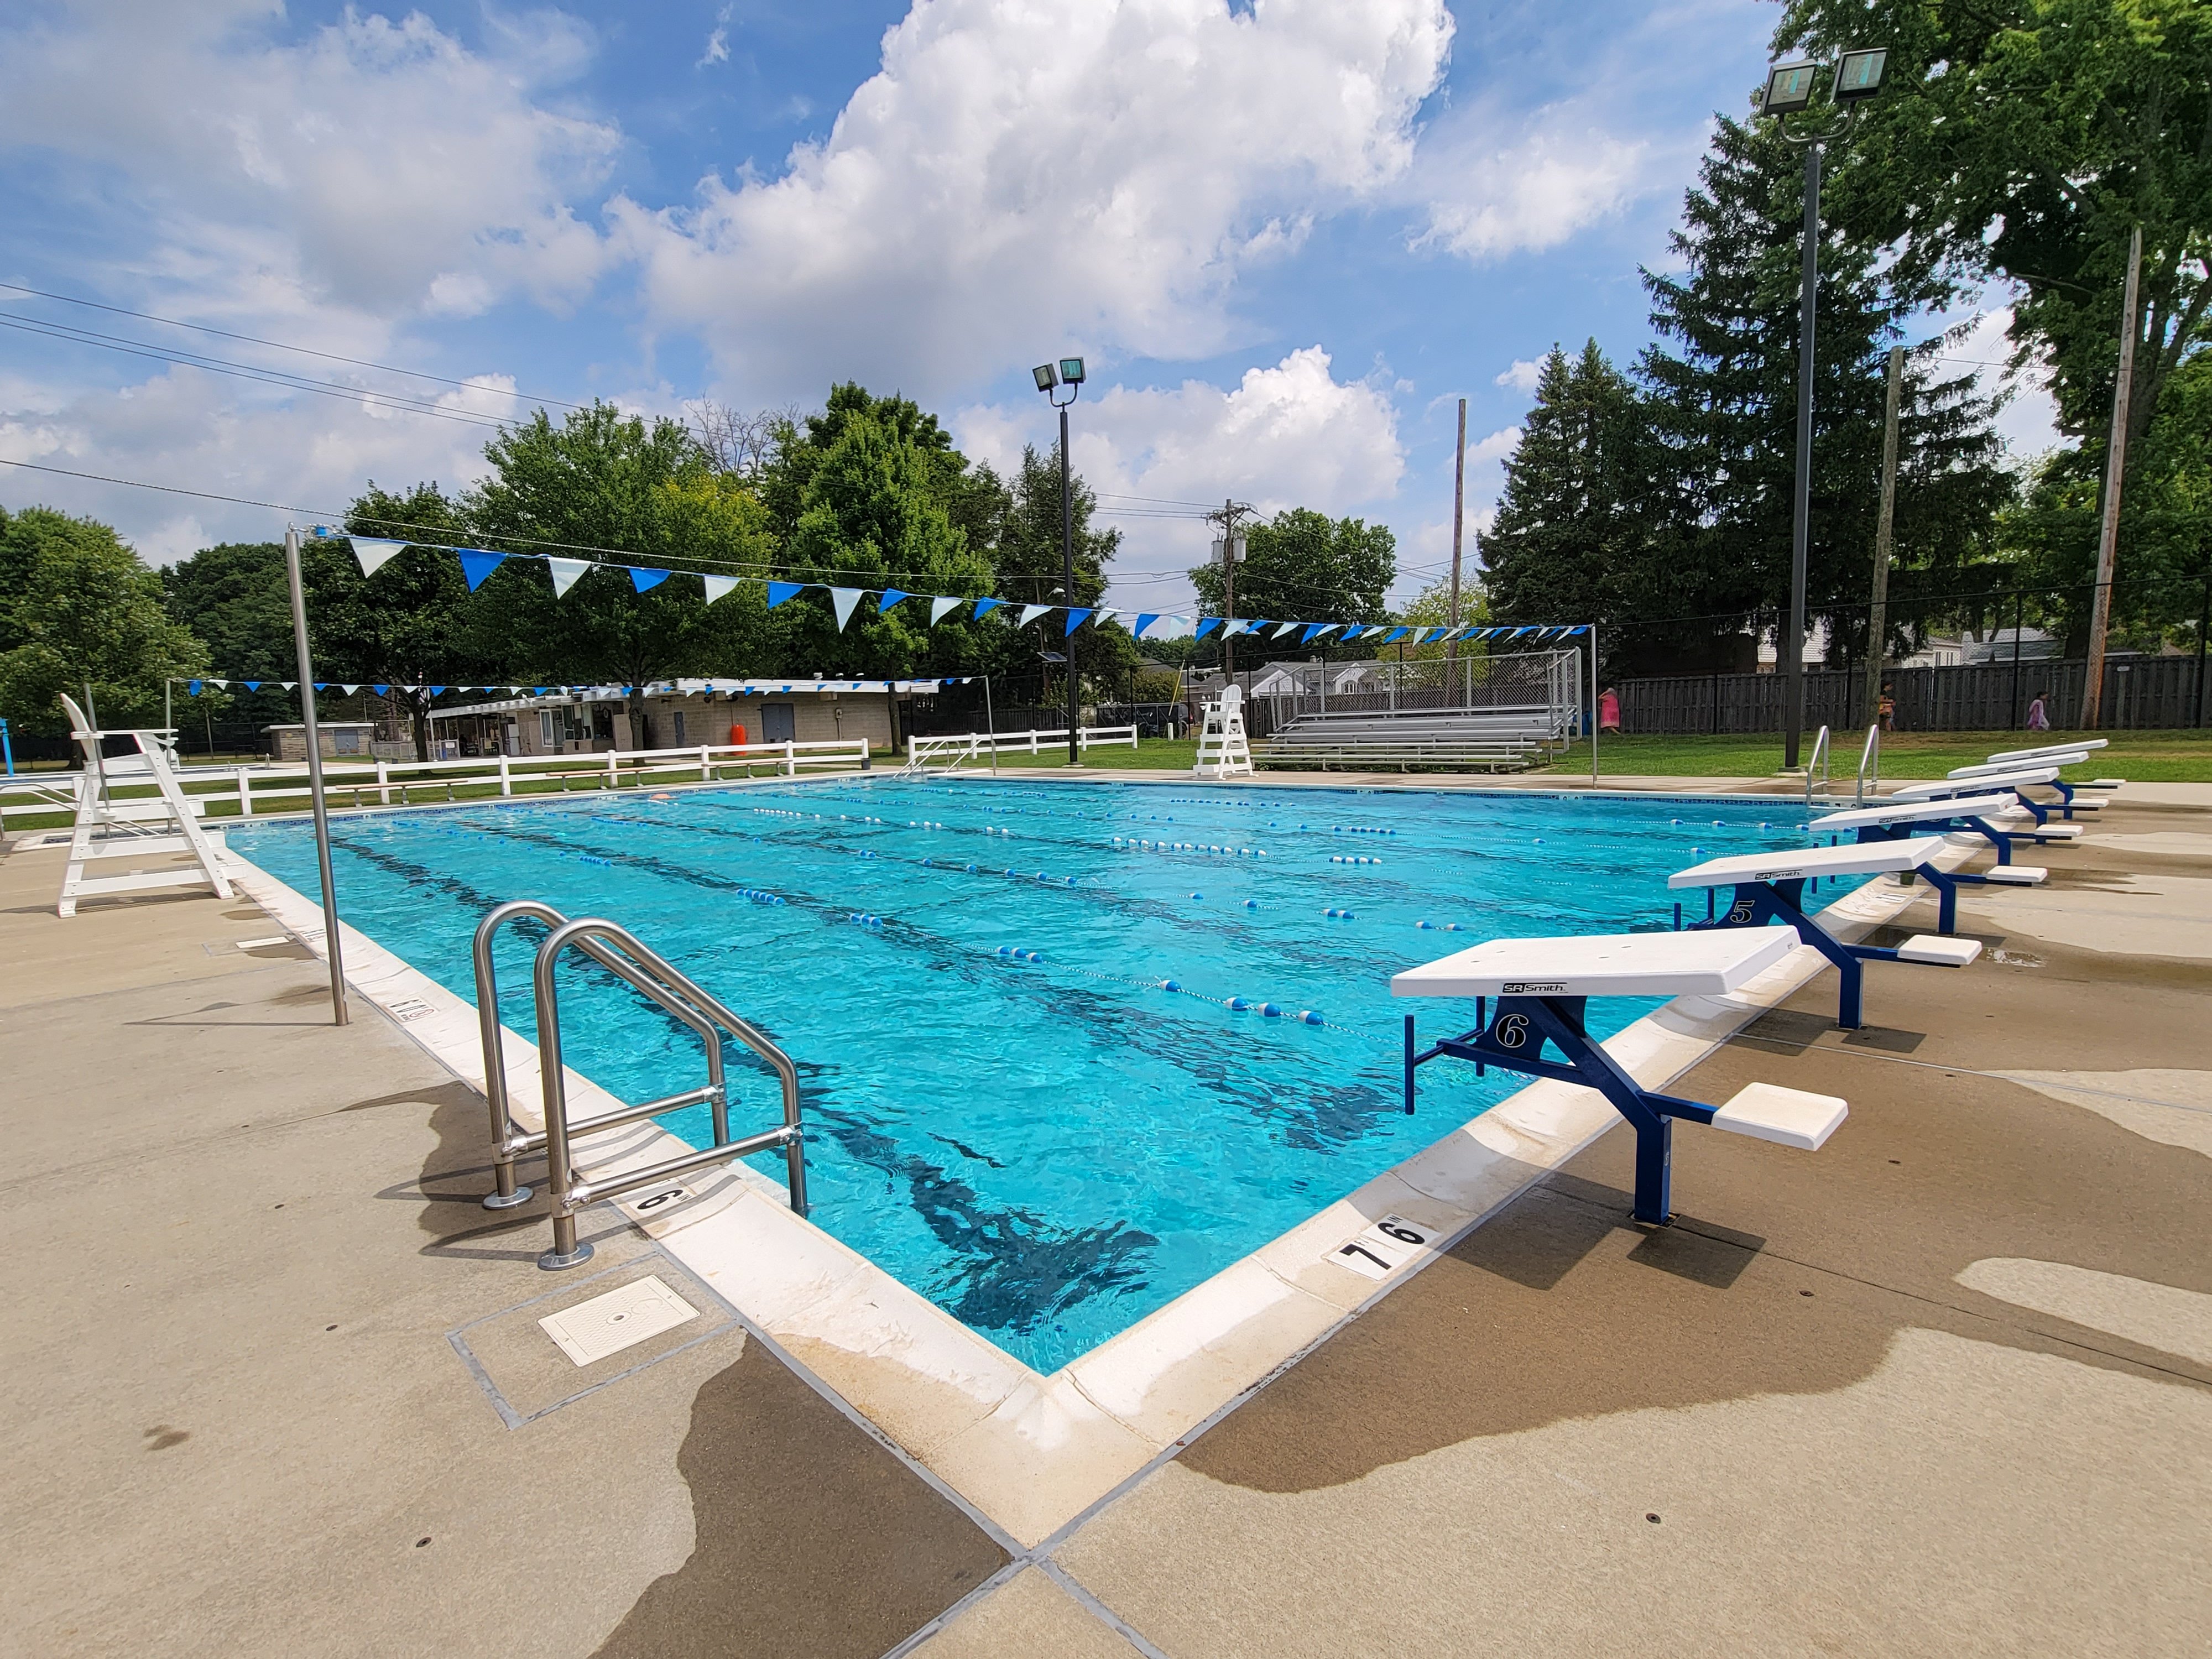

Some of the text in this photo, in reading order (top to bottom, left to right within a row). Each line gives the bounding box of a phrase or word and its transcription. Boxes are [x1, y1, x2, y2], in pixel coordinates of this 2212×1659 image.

[1730, 900, 1755, 924] 5
[1496, 1014, 1530, 1048] 6
[637, 1189, 684, 1210] 6
[1378, 1222, 1426, 1245] 6
[1338, 1243, 1392, 1271] 7
